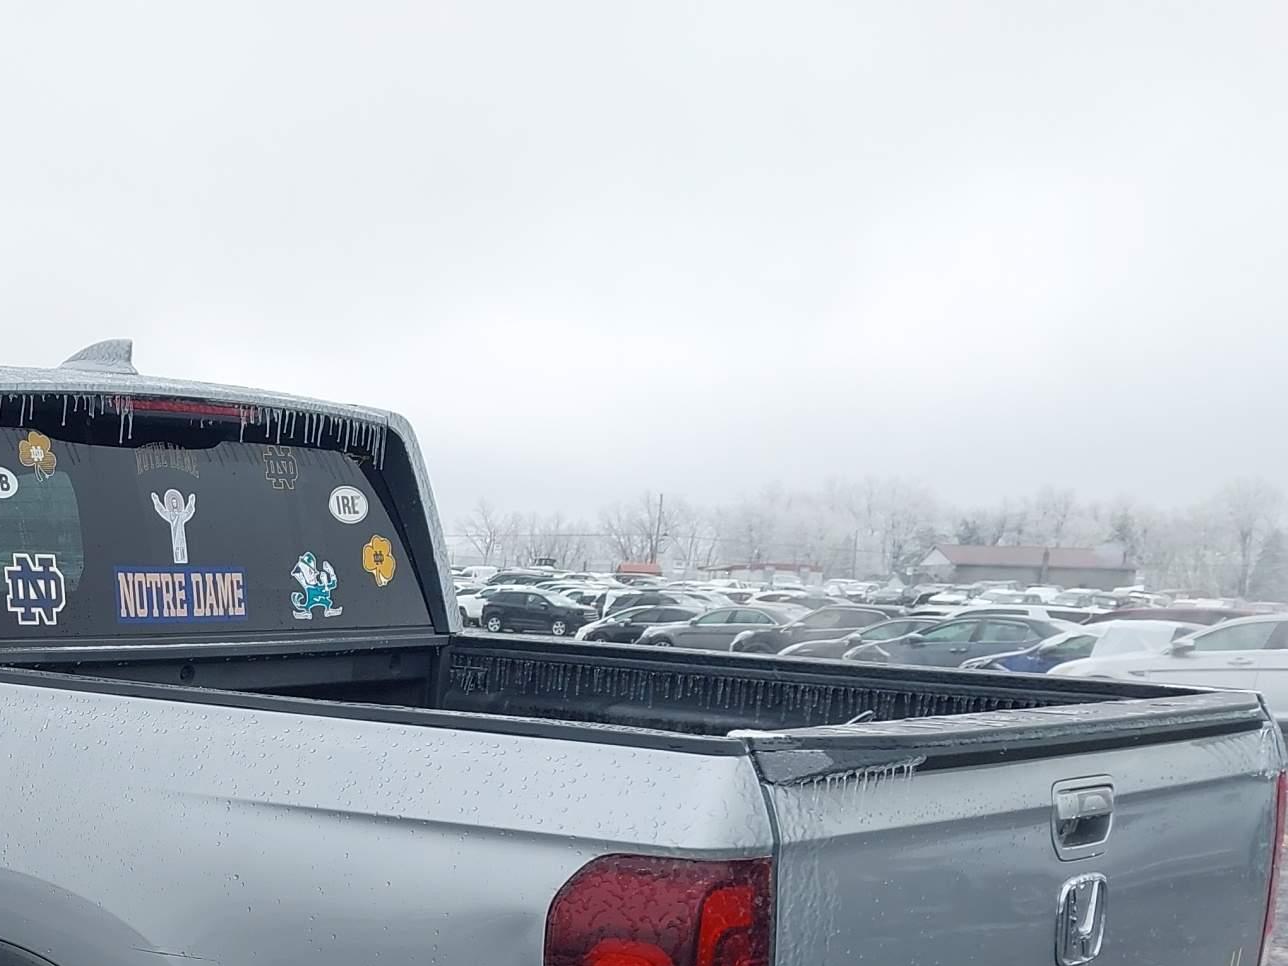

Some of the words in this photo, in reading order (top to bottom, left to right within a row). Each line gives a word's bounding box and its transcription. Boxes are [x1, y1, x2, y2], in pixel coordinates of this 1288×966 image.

[335, 495, 361, 515] IRE
[117, 571, 189, 618] NOTRE
[190, 571, 246, 617] DAME
